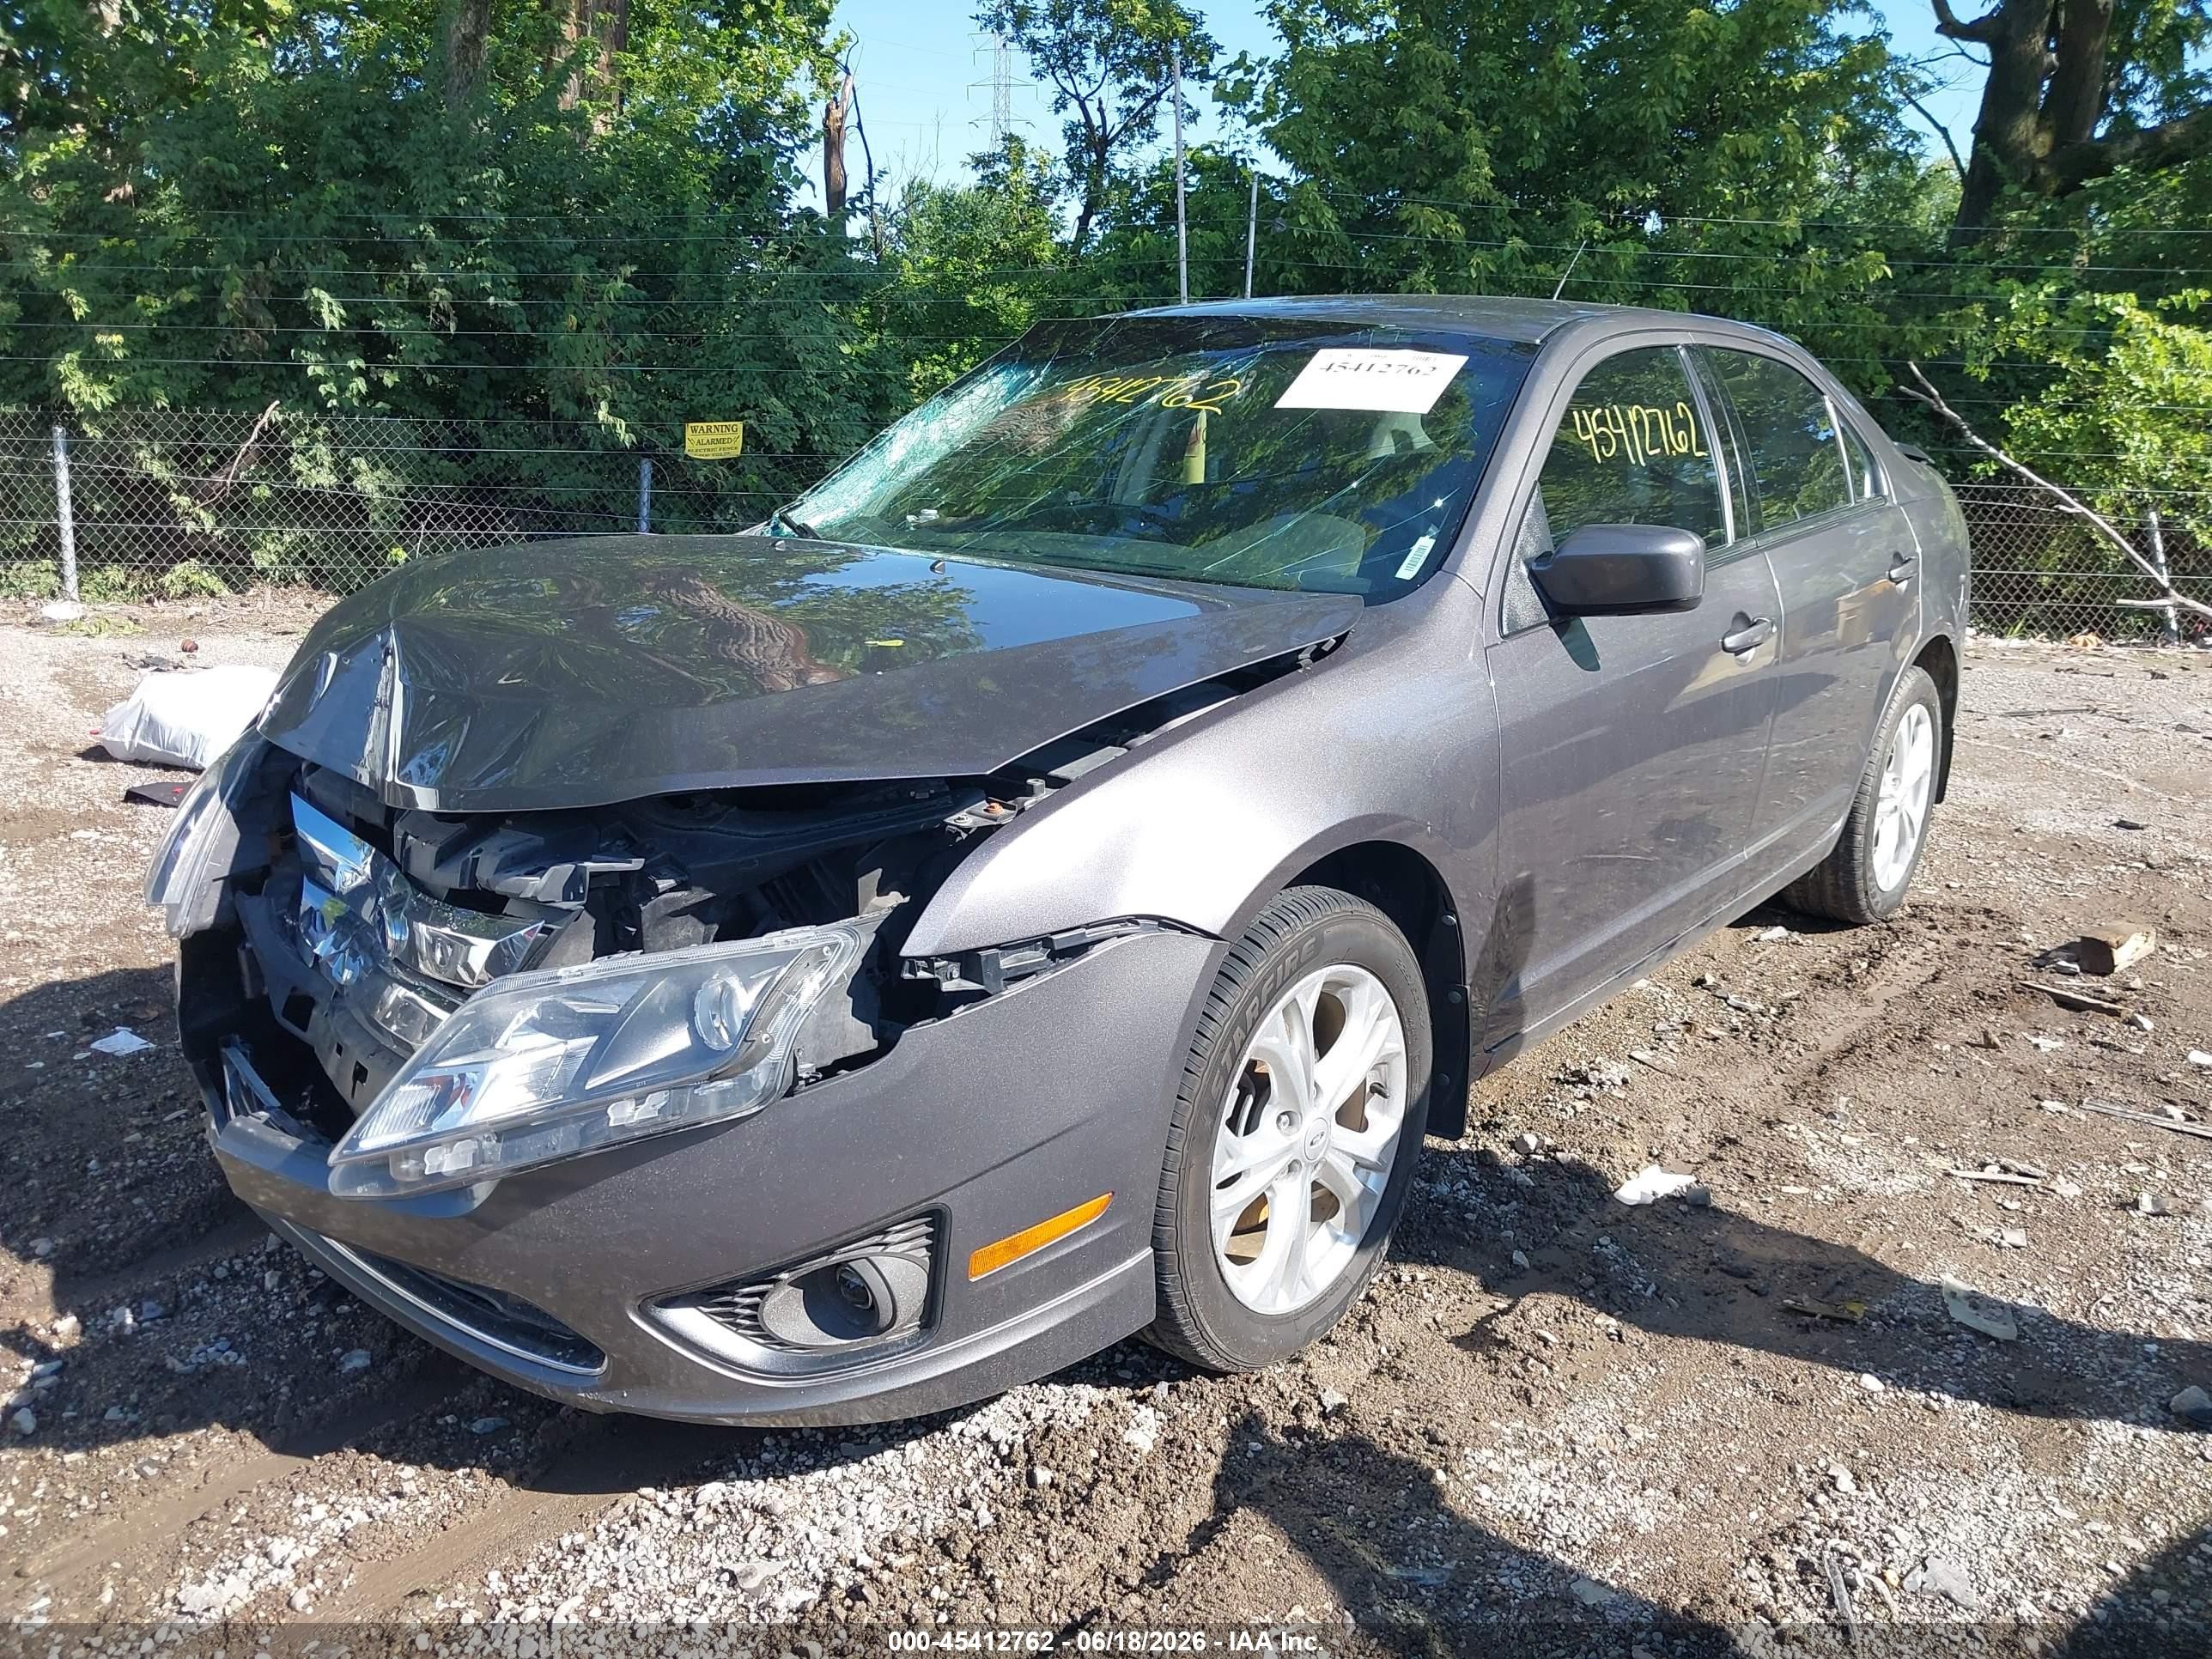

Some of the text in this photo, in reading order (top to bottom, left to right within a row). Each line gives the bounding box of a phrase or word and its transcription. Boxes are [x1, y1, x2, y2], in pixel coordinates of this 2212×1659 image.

[1320, 362, 1437, 376] 45412762
[1060, 376, 1240, 416] 45412762
[690, 424, 738, 434] WARNING
[1573, 402, 1708, 466] 45412762
[1210, 935, 1316, 1099] STARFIRE
